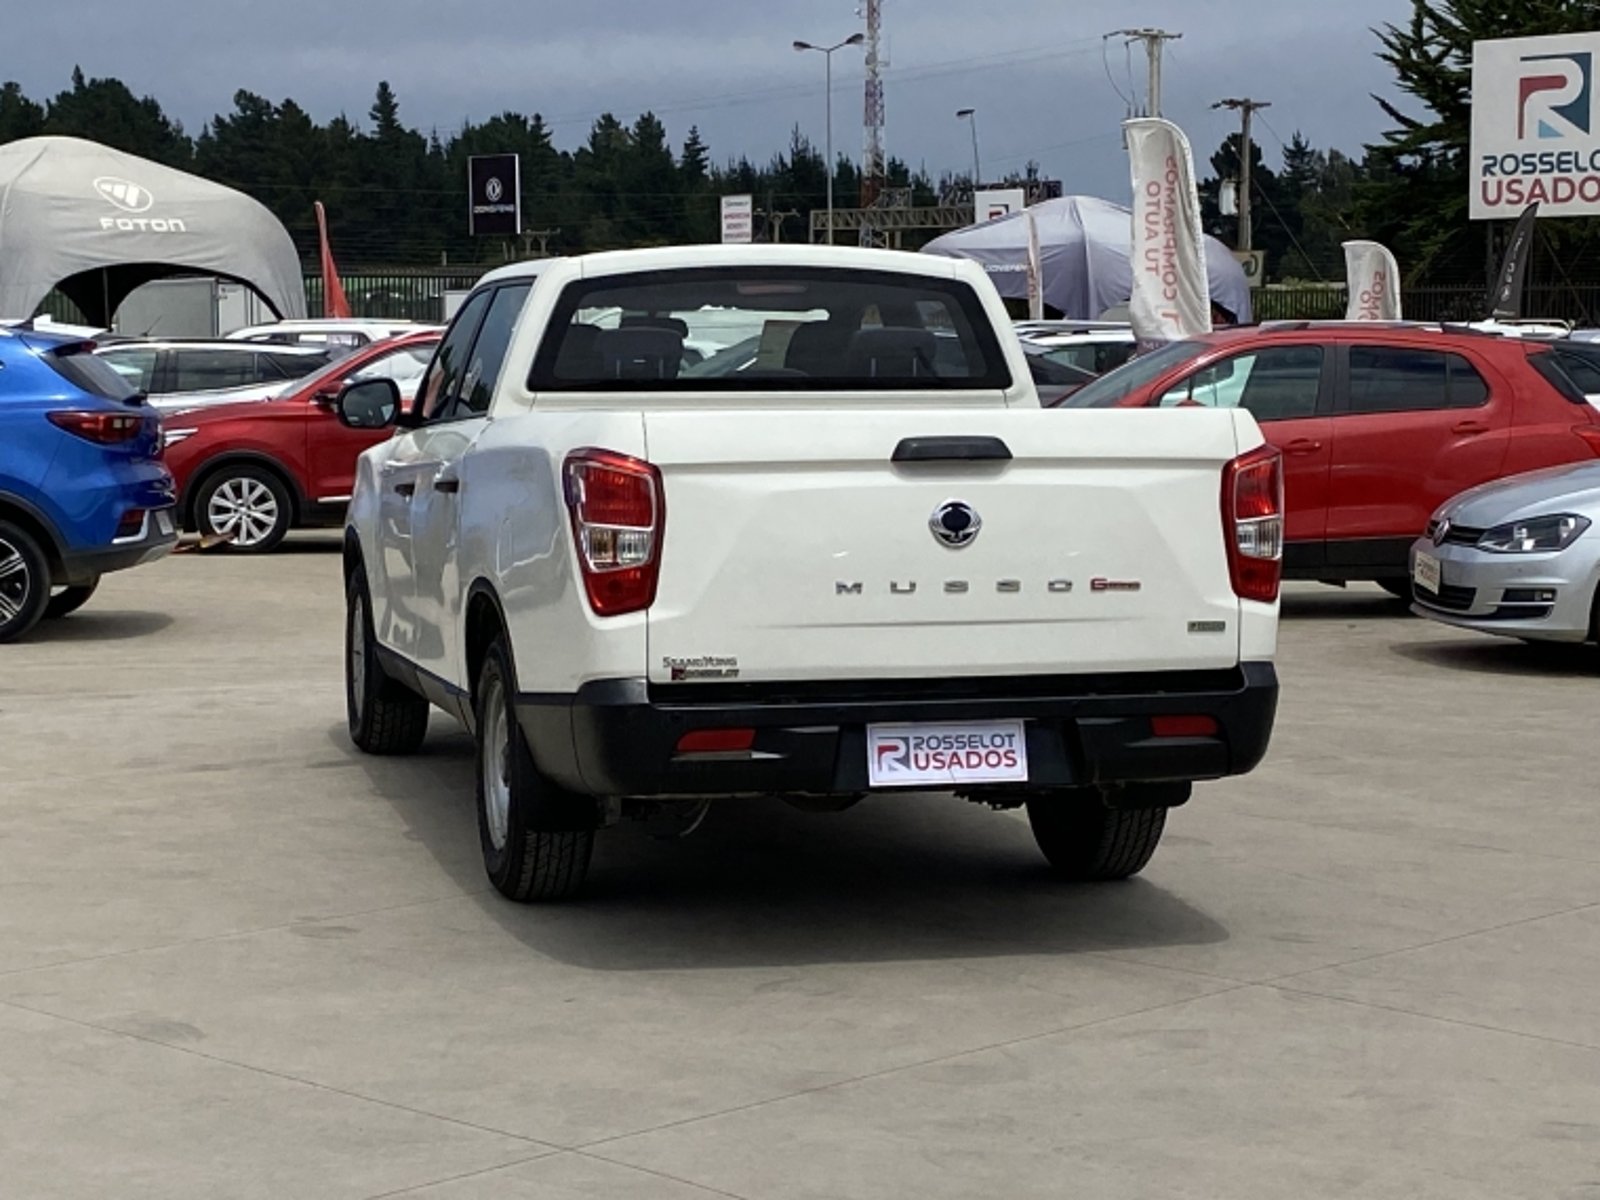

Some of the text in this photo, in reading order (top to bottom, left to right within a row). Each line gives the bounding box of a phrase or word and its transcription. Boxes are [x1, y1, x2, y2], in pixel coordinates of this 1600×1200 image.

[1481, 175, 1600, 206] USADO
[99, 217, 187, 233] FOTON
[835, 579, 1073, 595] MUSSO
[913, 734, 1016, 751] ROSSELOT
[913, 750, 1018, 771] USADOS
